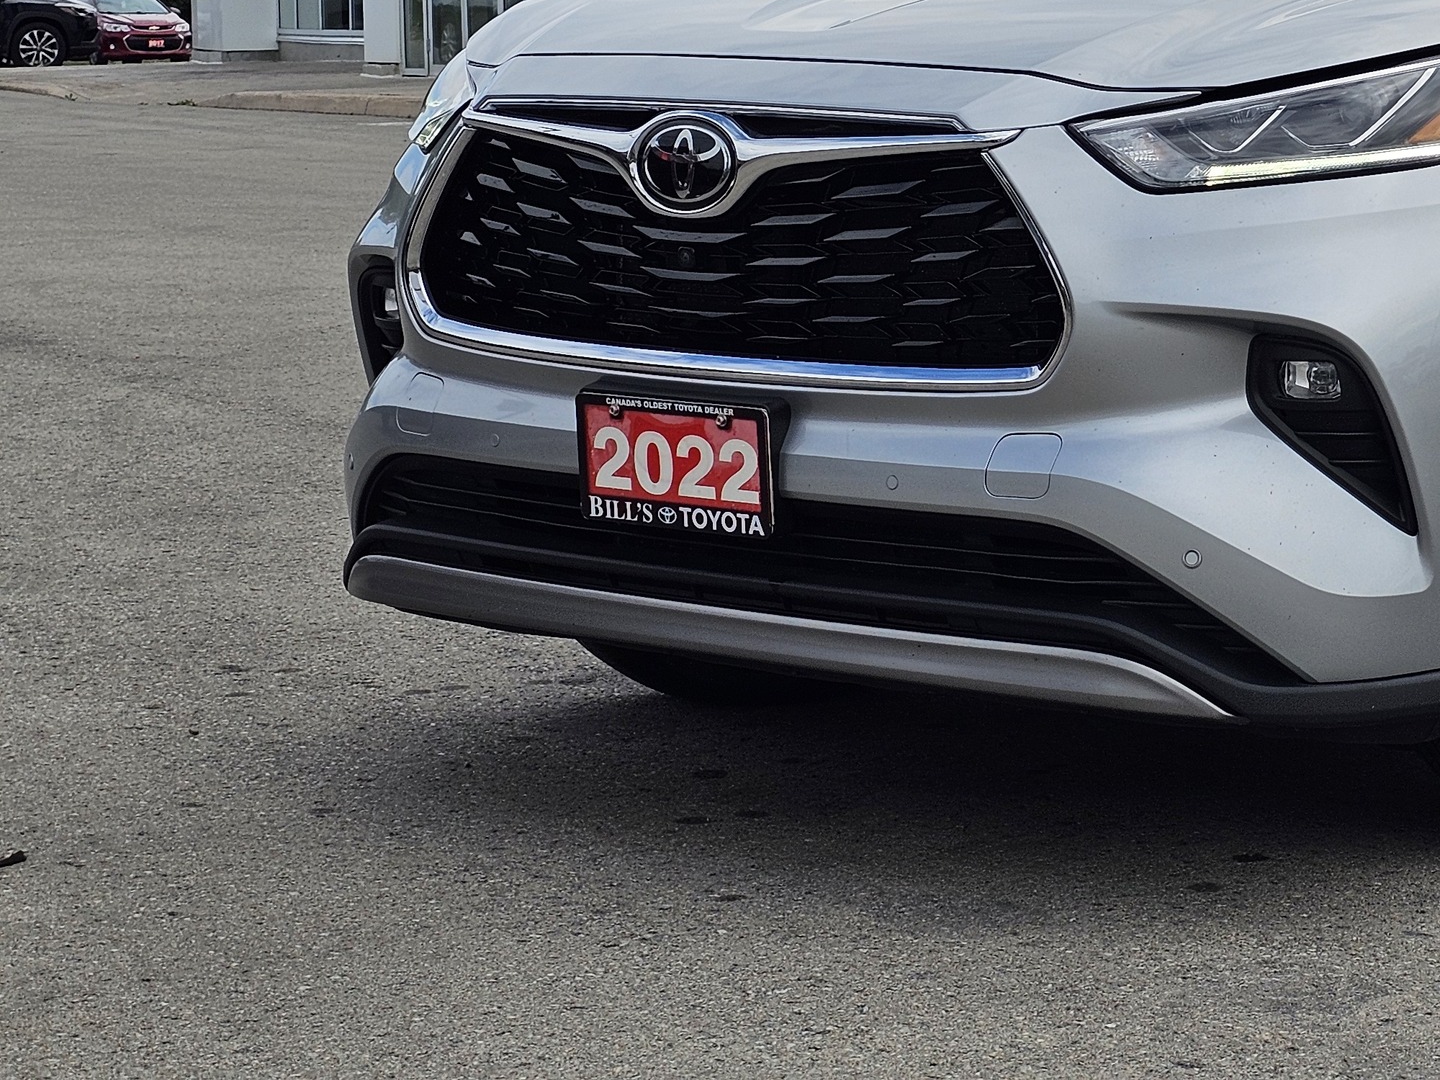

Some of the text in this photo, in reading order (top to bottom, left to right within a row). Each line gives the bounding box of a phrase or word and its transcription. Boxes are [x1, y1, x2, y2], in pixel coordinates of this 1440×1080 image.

[605, 397, 734, 416] CANADA'S OLDEST TOYOTA DEALER
[593, 426, 760, 505] 2022
[588, 495, 765, 536] BILL'S TOYOTA
